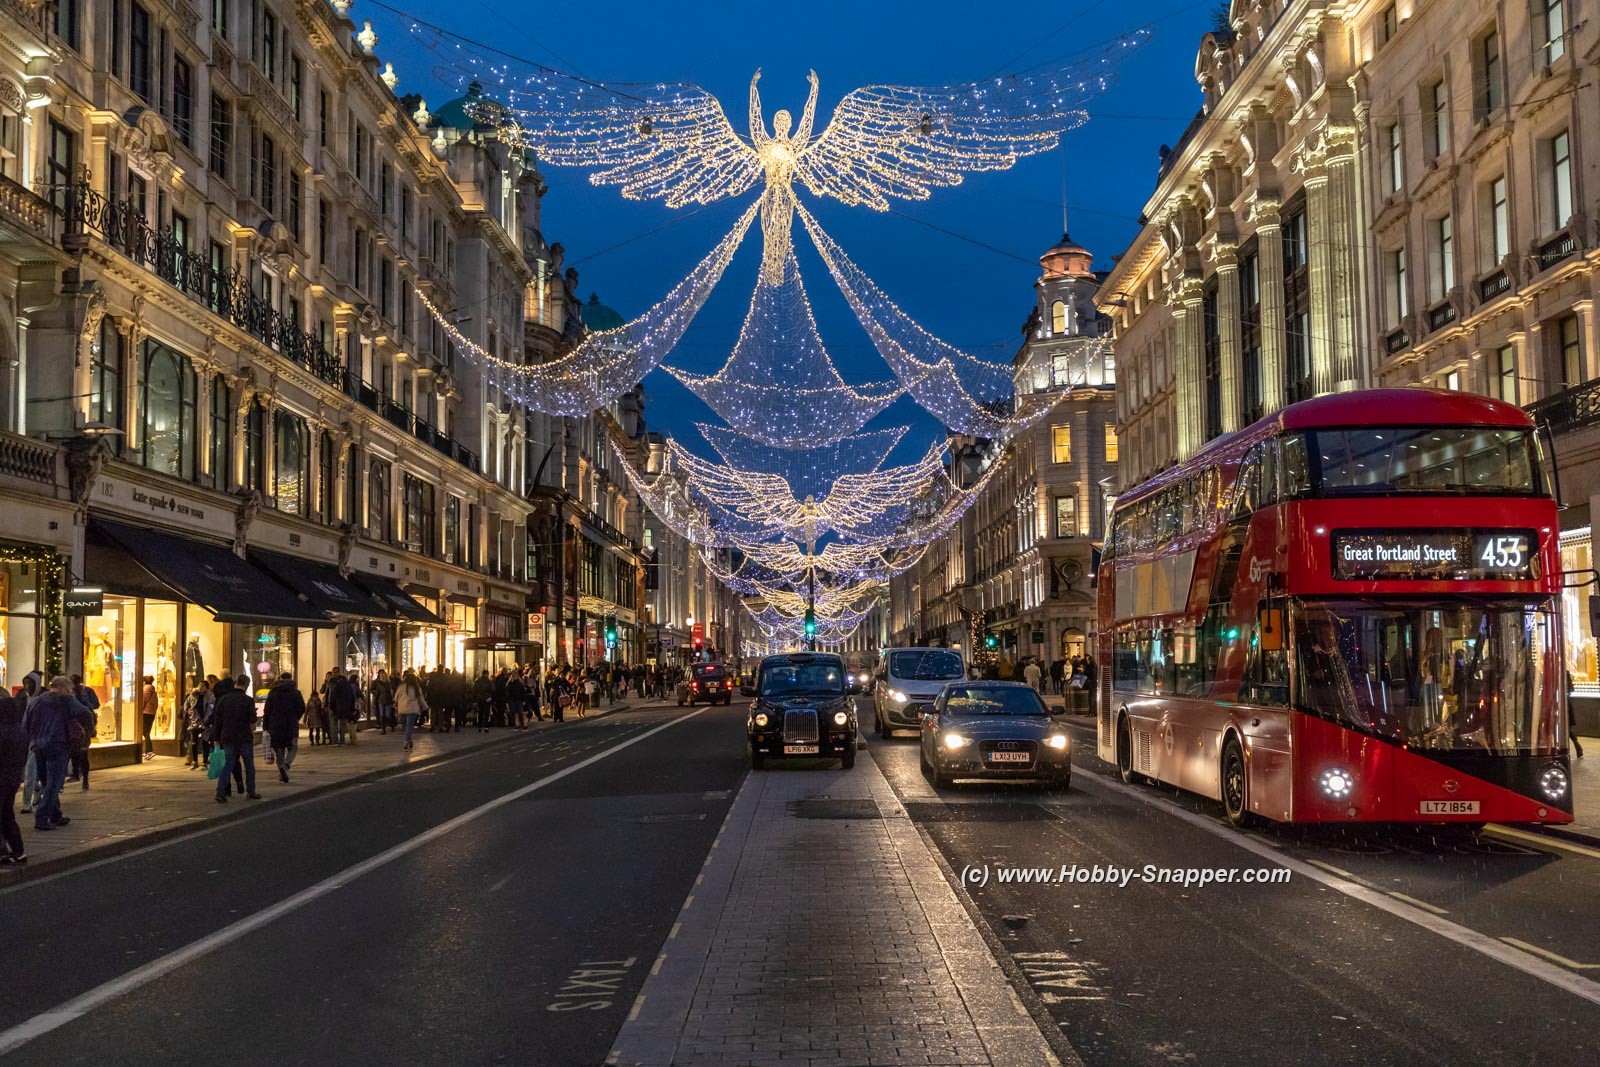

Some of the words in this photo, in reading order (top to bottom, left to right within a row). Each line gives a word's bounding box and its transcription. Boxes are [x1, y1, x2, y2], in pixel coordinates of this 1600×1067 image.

[101, 482, 114, 498] 182
[1343, 545, 1374, 561] Great
[1376, 544, 1421, 561] Portland
[1423, 544, 1457, 561] Street
[1481, 537, 1522, 567] 453
[1426, 802, 1447, 812] LTZ
[1450, 802, 1473, 812] 1854
[545, 956, 638, 1012] TAXIS
